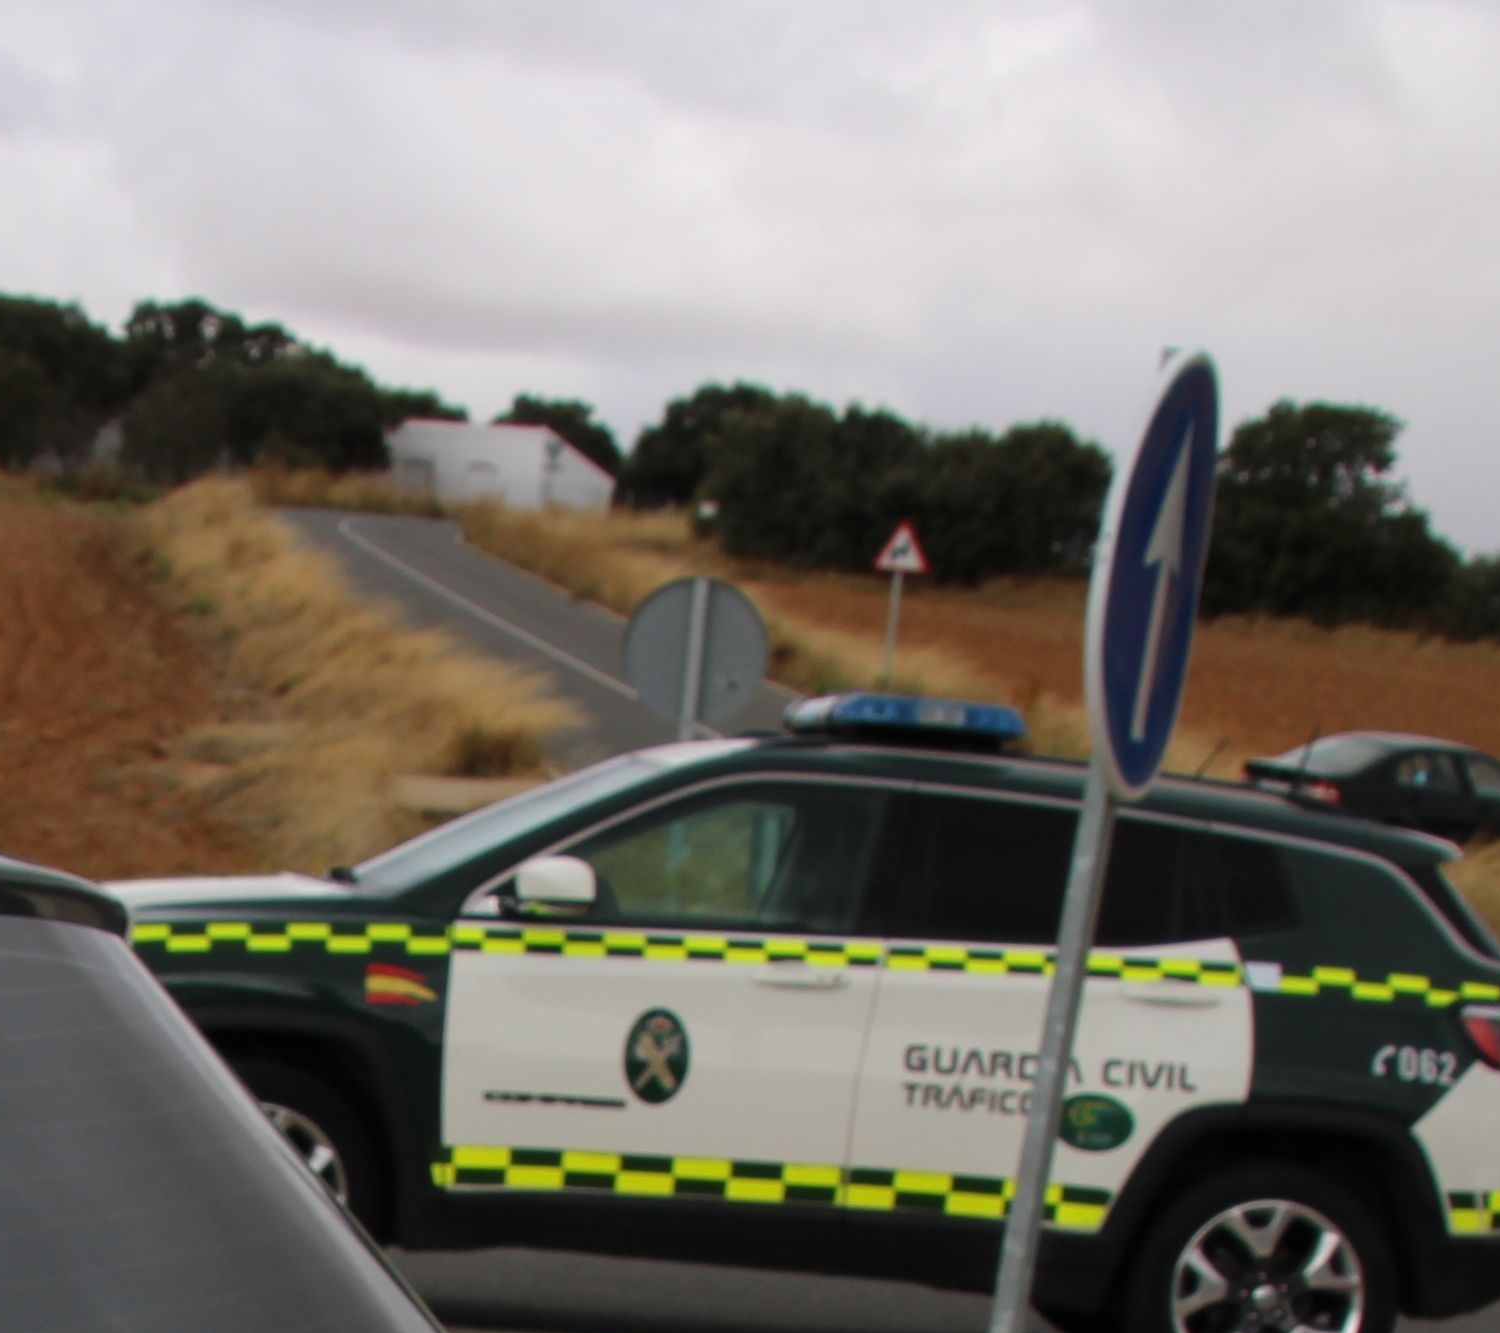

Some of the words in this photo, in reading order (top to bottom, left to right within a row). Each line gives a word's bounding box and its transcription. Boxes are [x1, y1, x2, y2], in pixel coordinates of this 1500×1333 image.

[903, 1044, 1084, 1084] GUARDA
[1102, 1058, 1196, 1093] CIVIL
[1398, 1045, 1457, 1087] 062
